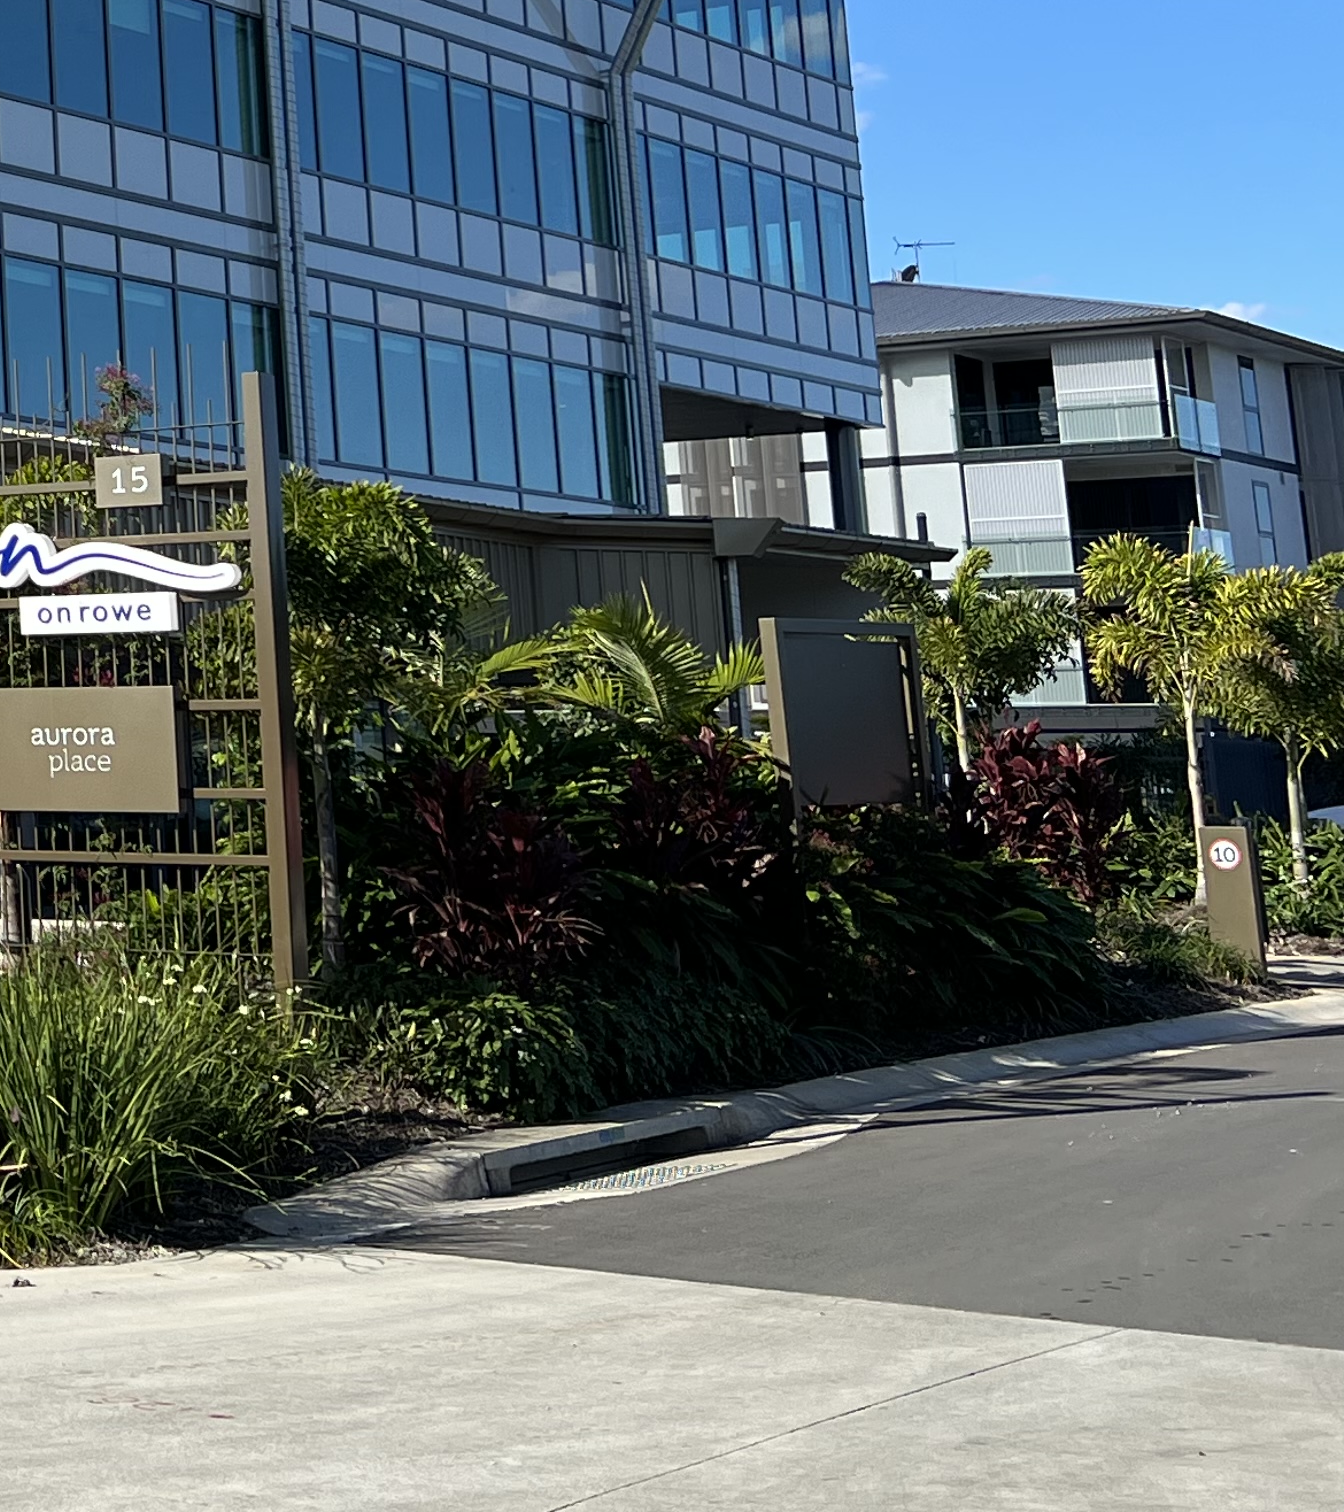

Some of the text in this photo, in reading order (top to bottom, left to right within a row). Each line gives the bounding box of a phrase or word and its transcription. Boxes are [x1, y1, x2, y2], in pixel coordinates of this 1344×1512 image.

[112, 466, 148, 494] 15
[37, 603, 152, 624] on rowe
[30, 727, 116, 746] aurora
[48, 747, 112, 779] place
[1213, 846, 1236, 863] 10
